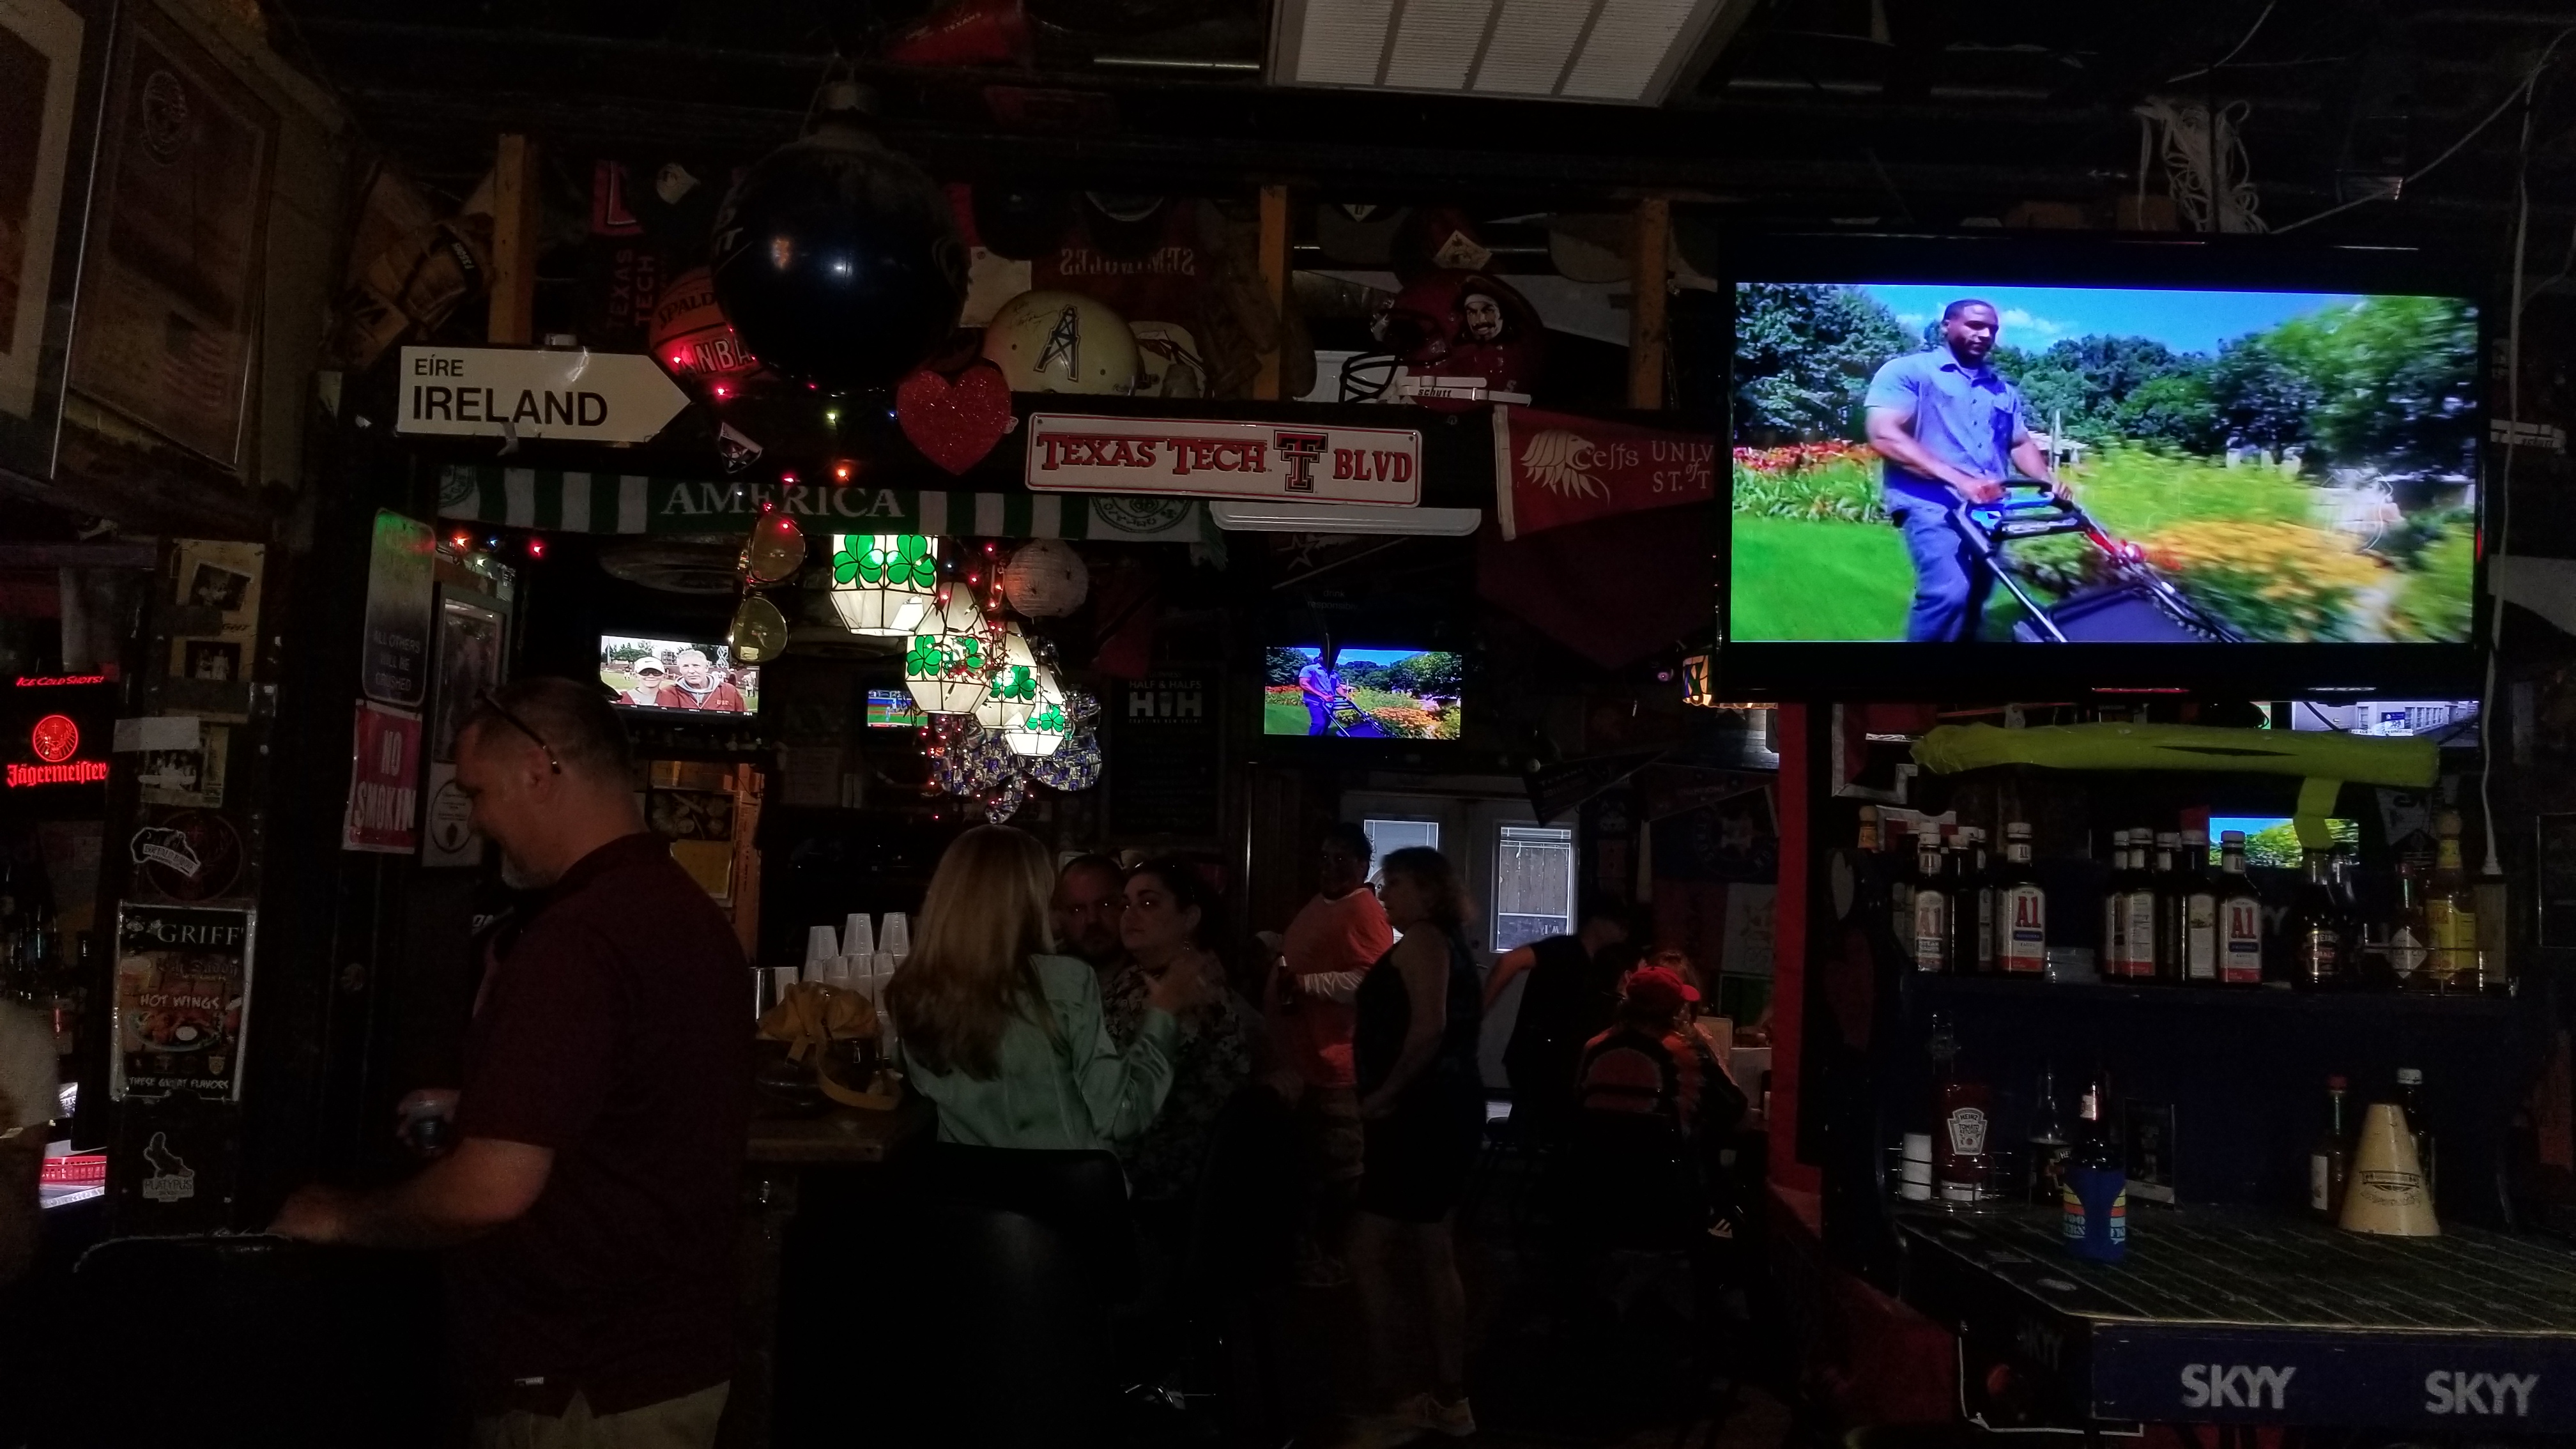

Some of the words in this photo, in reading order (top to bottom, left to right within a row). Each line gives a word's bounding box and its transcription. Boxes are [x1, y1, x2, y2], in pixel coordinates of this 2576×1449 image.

[606, 248, 634, 329] TEXAS
[634, 256, 656, 327] TECH
[415, 354, 464, 377] EÍRE
[694, 339, 754, 374] NBA
[413, 386, 608, 426] IRELAND
[1037, 431, 1165, 470] TEXAS
[1167, 438, 1268, 475] TECH
[1332, 448, 1413, 483] BLVD
[660, 481, 905, 518] AMERICA
[16, 676, 36, 687] ICE
[36, 676, 66, 686] COLD
[66, 675, 105, 686] SHOTS!
[1129, 680, 1156, 689] HALF
[1158, 680, 1167, 689] &
[1169, 680, 1202, 689] HALFS
[380, 729, 402, 777] NO
[2015, 896, 2041, 928] A1
[2231, 907, 2257, 939] A1
[140, 994, 169, 1008] HOT
[172, 995, 220, 1009] WINGS
[2181, 1363, 2297, 1409] SKYY
[2423, 1370, 2540, 1417] SKYY
